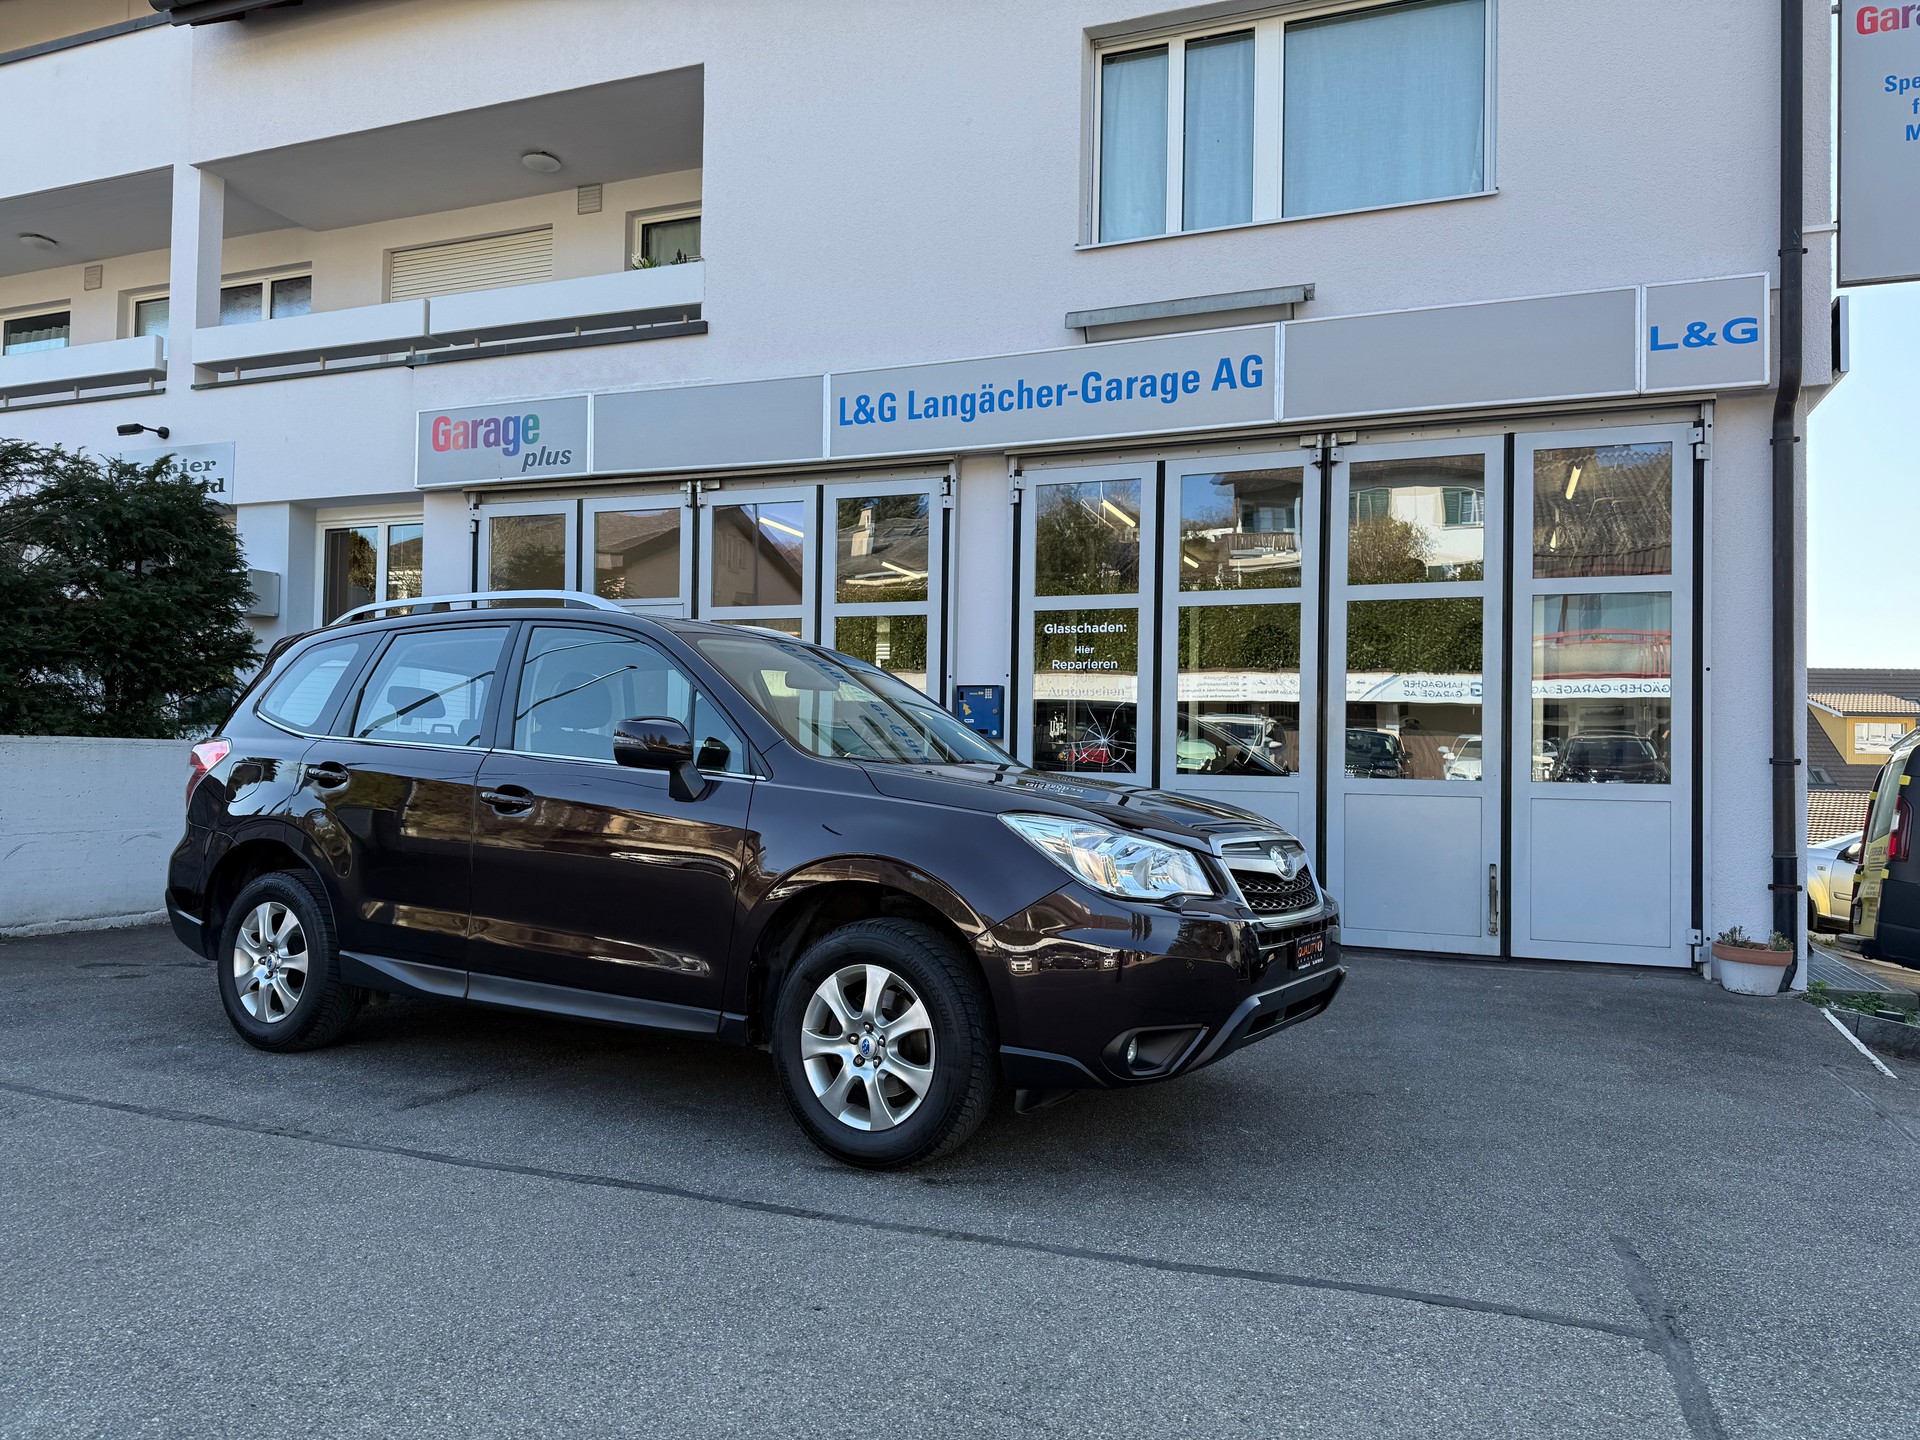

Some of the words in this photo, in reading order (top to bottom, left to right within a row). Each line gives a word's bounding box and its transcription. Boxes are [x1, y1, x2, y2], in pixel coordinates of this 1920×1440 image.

[1856, 4, 1920, 35] Gar
[1650, 317, 1758, 351] L&G
[839, 392, 897, 426] L&G
[907, 369, 1201, 424] Langächer-Garage
[1212, 354, 1263, 391] AG
[432, 413, 540, 457] Garage
[521, 445, 573, 473] plus
[1044, 623, 1127, 634] Glasschaden:
[1074, 645, 1095, 654] Hier
[1052, 659, 1118, 671] Reparieren
